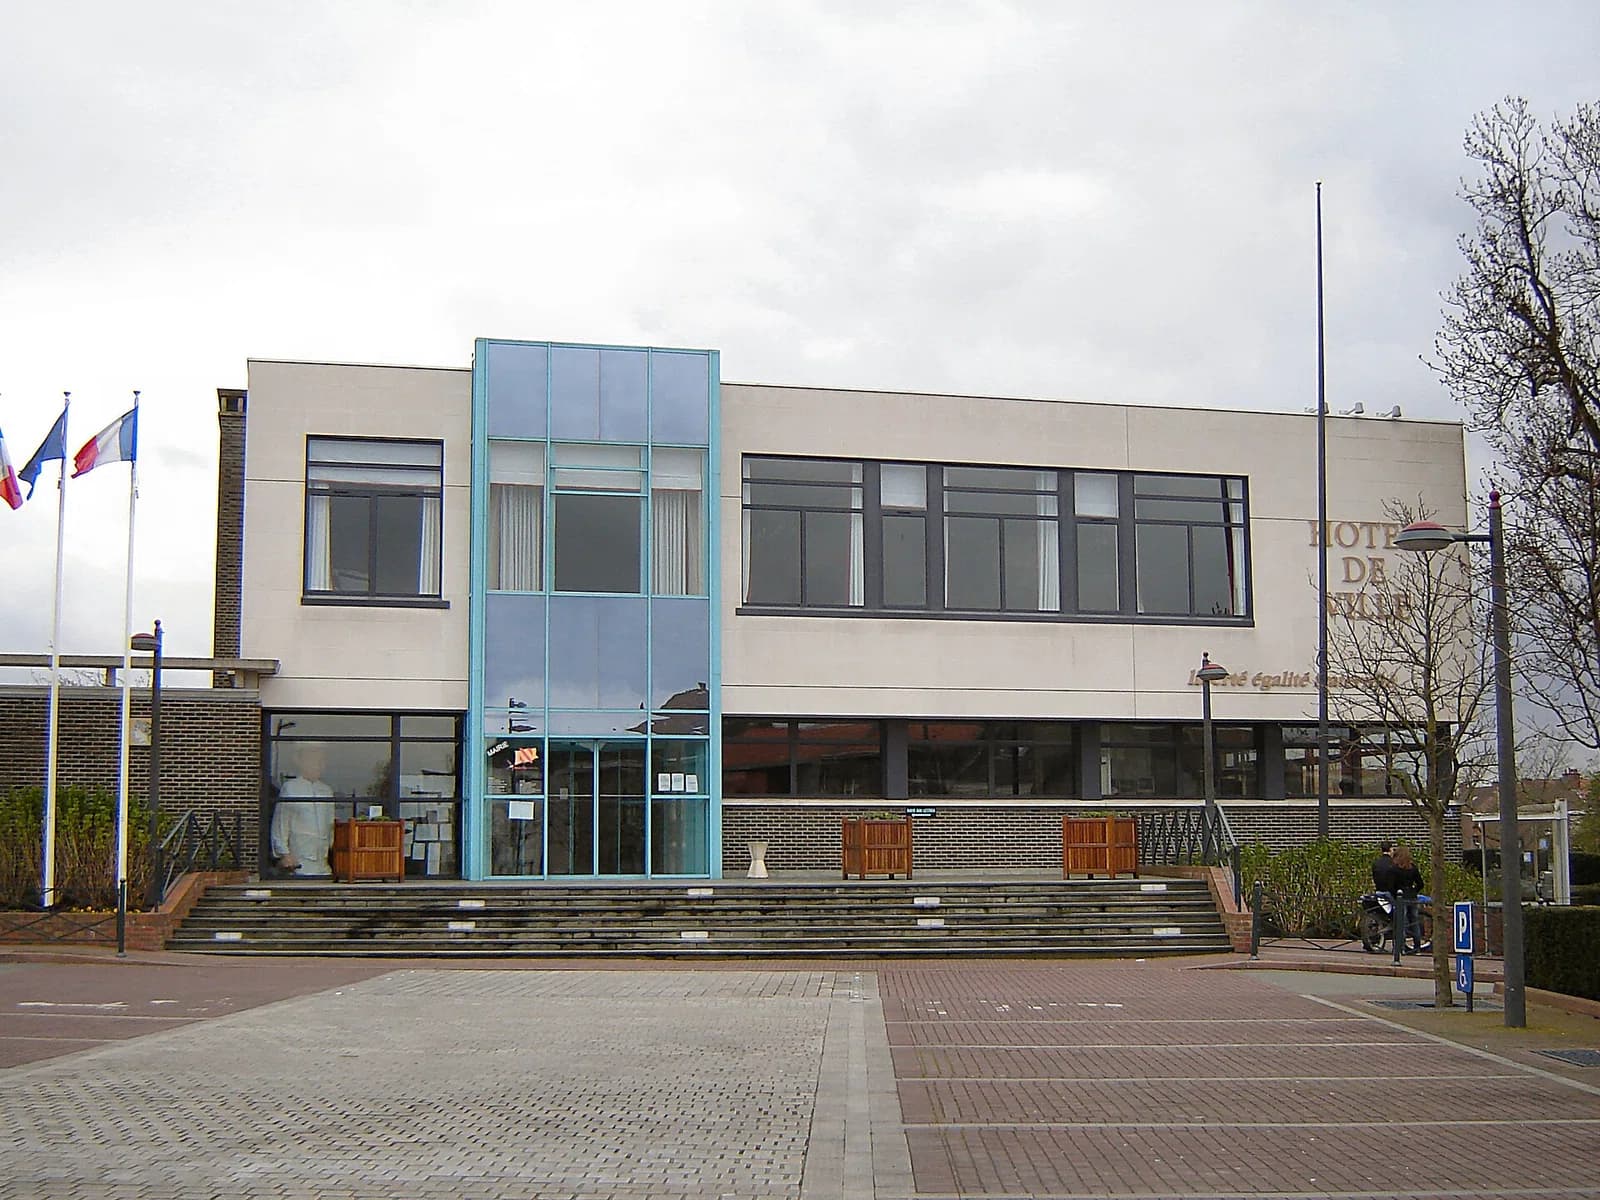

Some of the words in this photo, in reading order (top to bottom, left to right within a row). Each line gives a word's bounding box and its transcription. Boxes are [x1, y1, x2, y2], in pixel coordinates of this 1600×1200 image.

[1308, 520, 1401, 548] HOTE
[1342, 556, 1385, 583] DE
[1251, 671, 1310, 691] égalité
[1459, 911, 1467, 942] P
